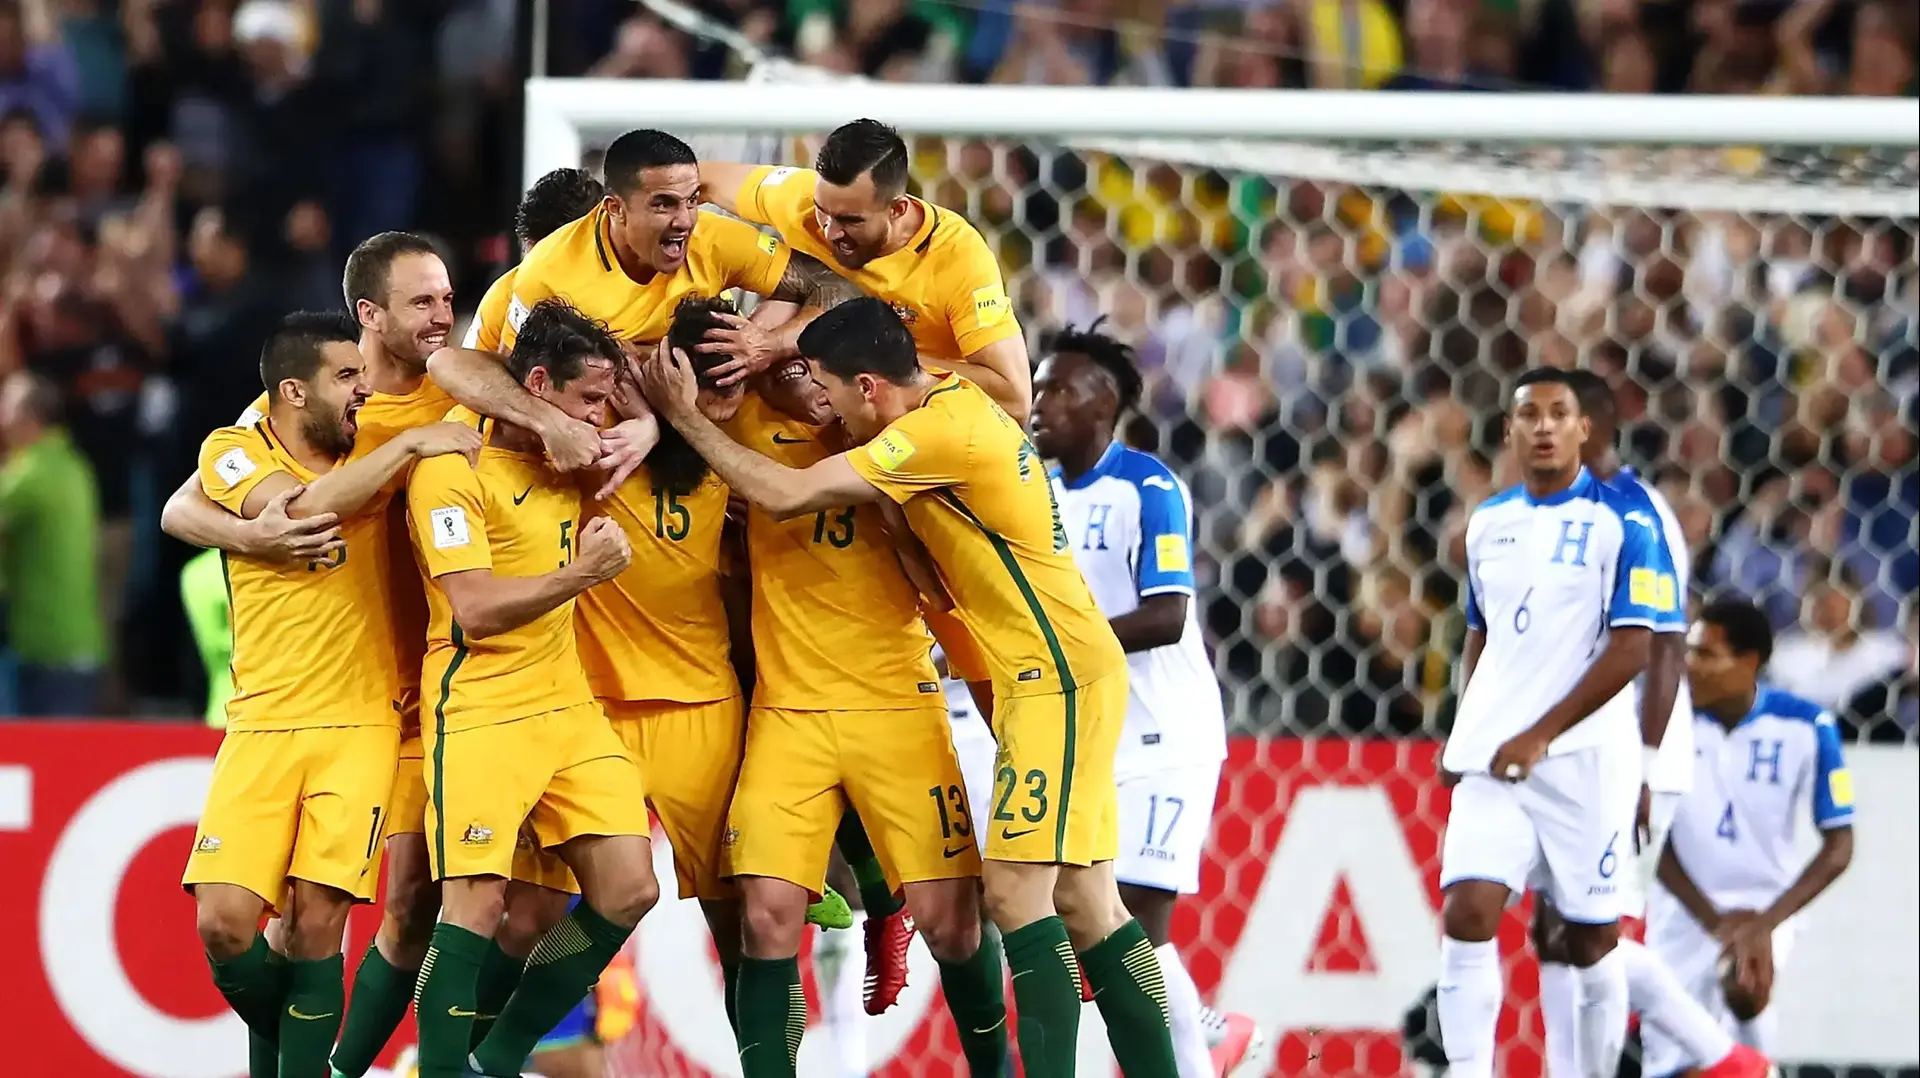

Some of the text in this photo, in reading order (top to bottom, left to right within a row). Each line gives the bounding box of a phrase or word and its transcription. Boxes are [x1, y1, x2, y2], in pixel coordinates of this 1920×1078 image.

[977, 299, 997, 309] FIFA
[651, 487, 690, 541] 15
[1082, 504, 1111, 550] H
[559, 520, 572, 568] 5
[1550, 520, 1594, 567] H
[1513, 586, 1534, 634] 6
[1746, 739, 1783, 784] H
[929, 785, 971, 839] 13
[994, 766, 1047, 823] 23
[1146, 795, 1184, 846] 17
[1716, 801, 1738, 845] 4
[1599, 830, 1618, 879] 6
